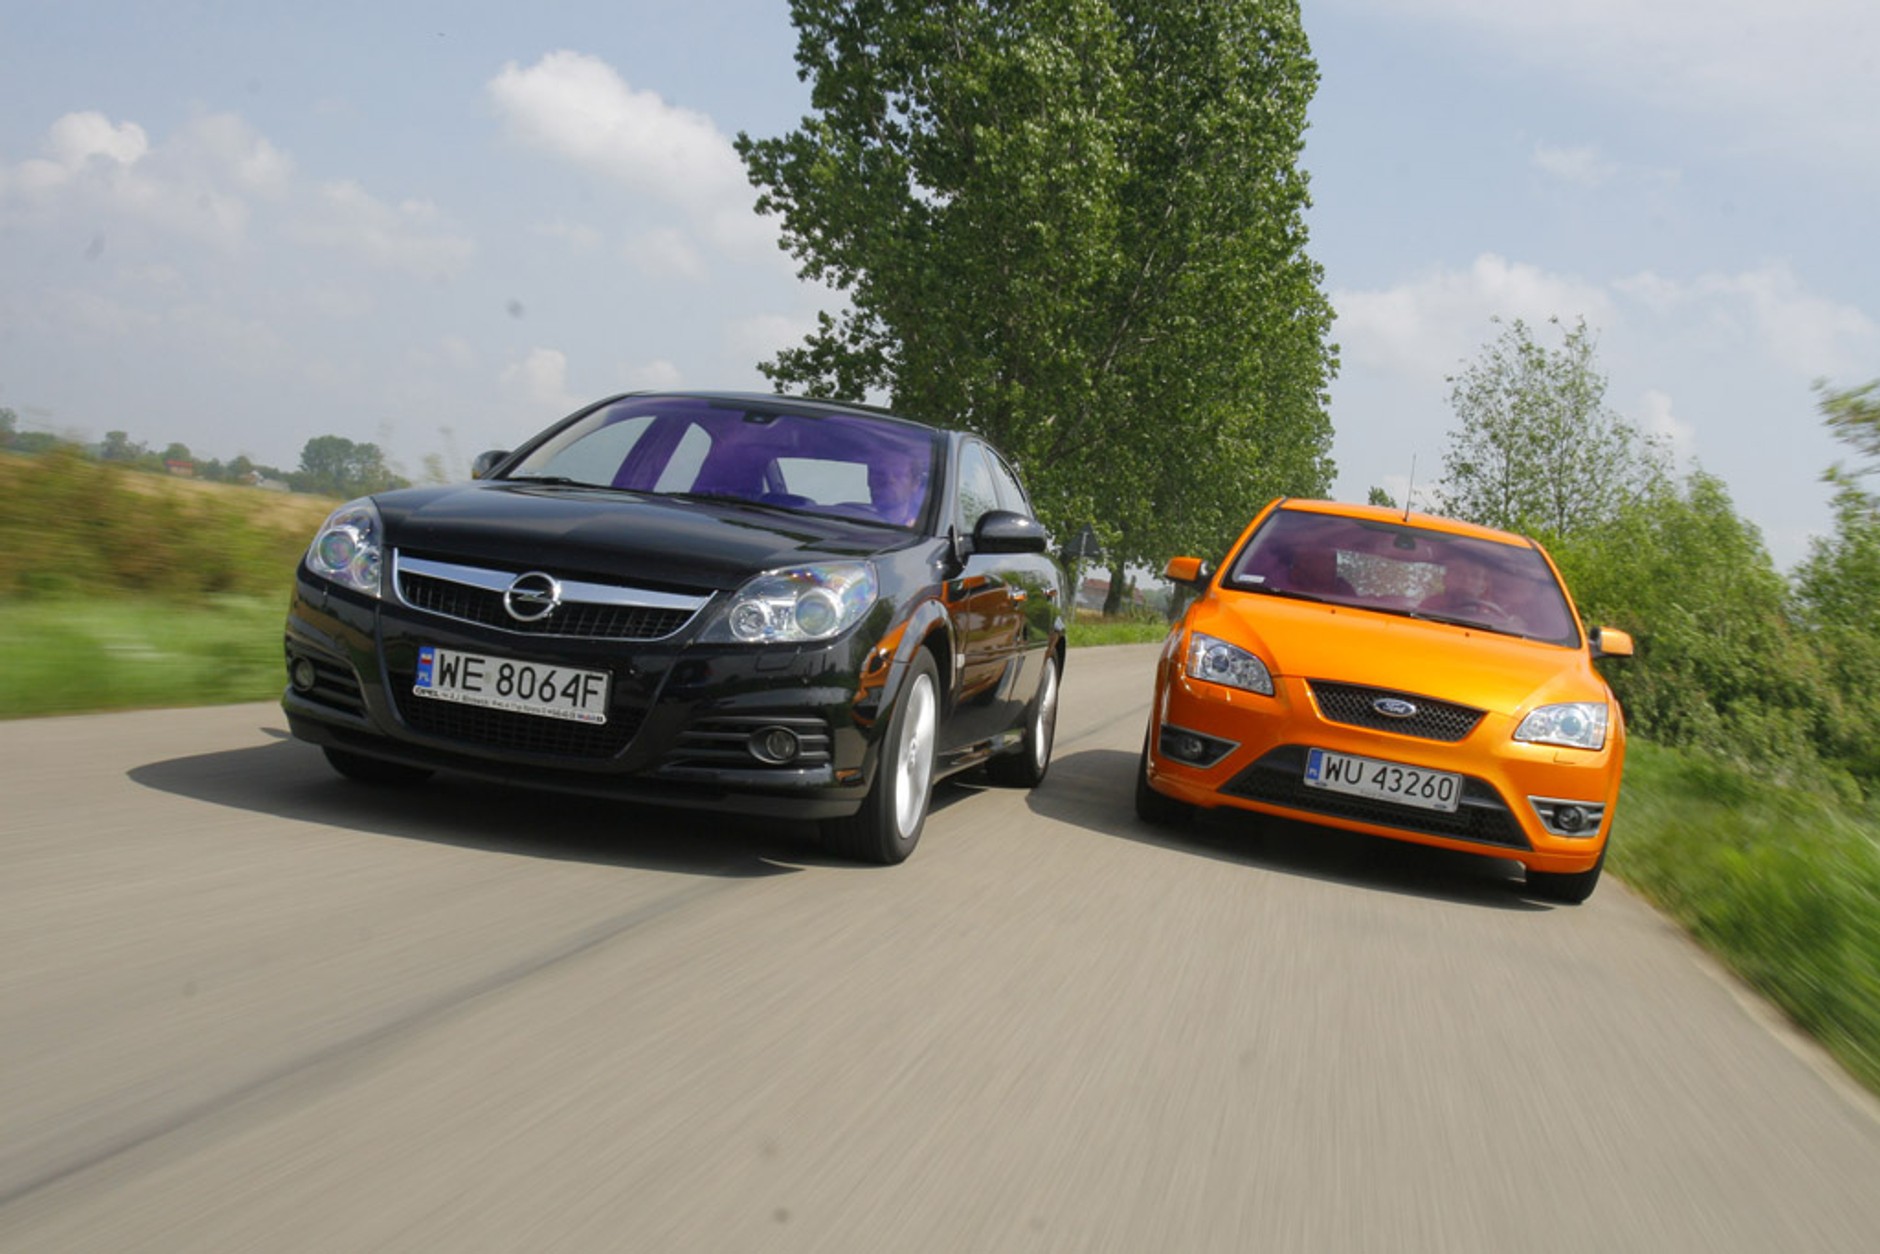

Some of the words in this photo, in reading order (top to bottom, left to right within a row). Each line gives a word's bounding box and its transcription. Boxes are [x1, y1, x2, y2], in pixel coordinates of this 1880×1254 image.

[438, 653, 485, 692] WE
[496, 662, 604, 709] 8064F
[1325, 756, 1364, 785] WU
[1371, 766, 1454, 802] 43260
